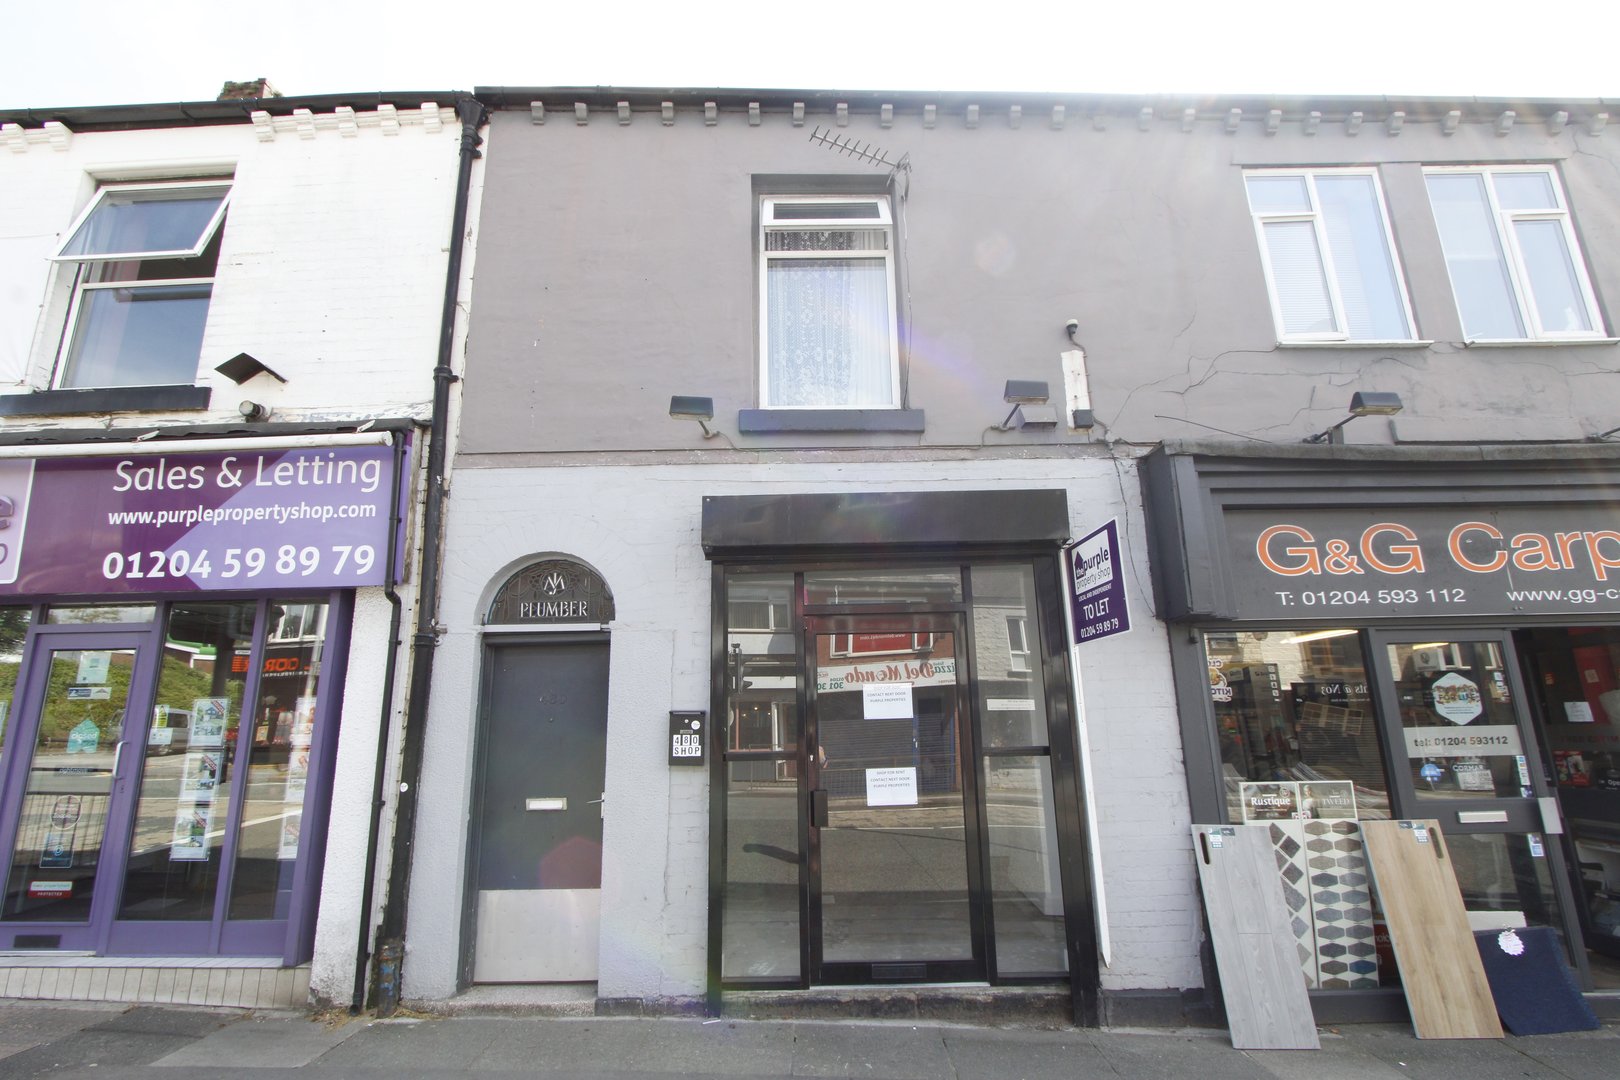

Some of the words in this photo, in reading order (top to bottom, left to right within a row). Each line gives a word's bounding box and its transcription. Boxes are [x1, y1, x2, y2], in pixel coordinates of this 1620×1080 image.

[113, 459, 205, 493] Sales
[216, 457, 243, 489] &
[255, 452, 382, 493] Letting
[108, 502, 376, 528] www.purplepropertyshop.com
[1082, 547, 1109, 573] purple
[1256, 524, 1425, 575] G&G
[102, 549, 212, 580] 01204
[221, 549, 266, 577] 59
[275, 545, 320, 575] 89
[332, 545, 375, 574] 79
[1076, 574, 1096, 590] property
[1097, 566, 1111, 579] shop
[1276, 591, 1294, 606] T:
[1302, 590, 1371, 606] 01204
[1378, 589, 1418, 604] 593
[1426, 588, 1466, 603] 112
[520, 601, 587, 618] PLUMBER
[1083, 603, 1095, 620] TO
[1095, 597, 1110, 617] LET
[1081, 622, 1096, 638] 01204
[1096, 622, 1103, 633] 59
[1104, 619, 1111, 630] 89
[1111, 617, 1119, 629] 79
[674, 736, 698, 744] 480
[674, 746, 700, 755] SHOP
[1414, 739, 1431, 747] tel:
[1435, 737, 1466, 746] 01204
[1470, 736, 1508, 745] 593112
[1251, 797, 1291, 807] Rustique
